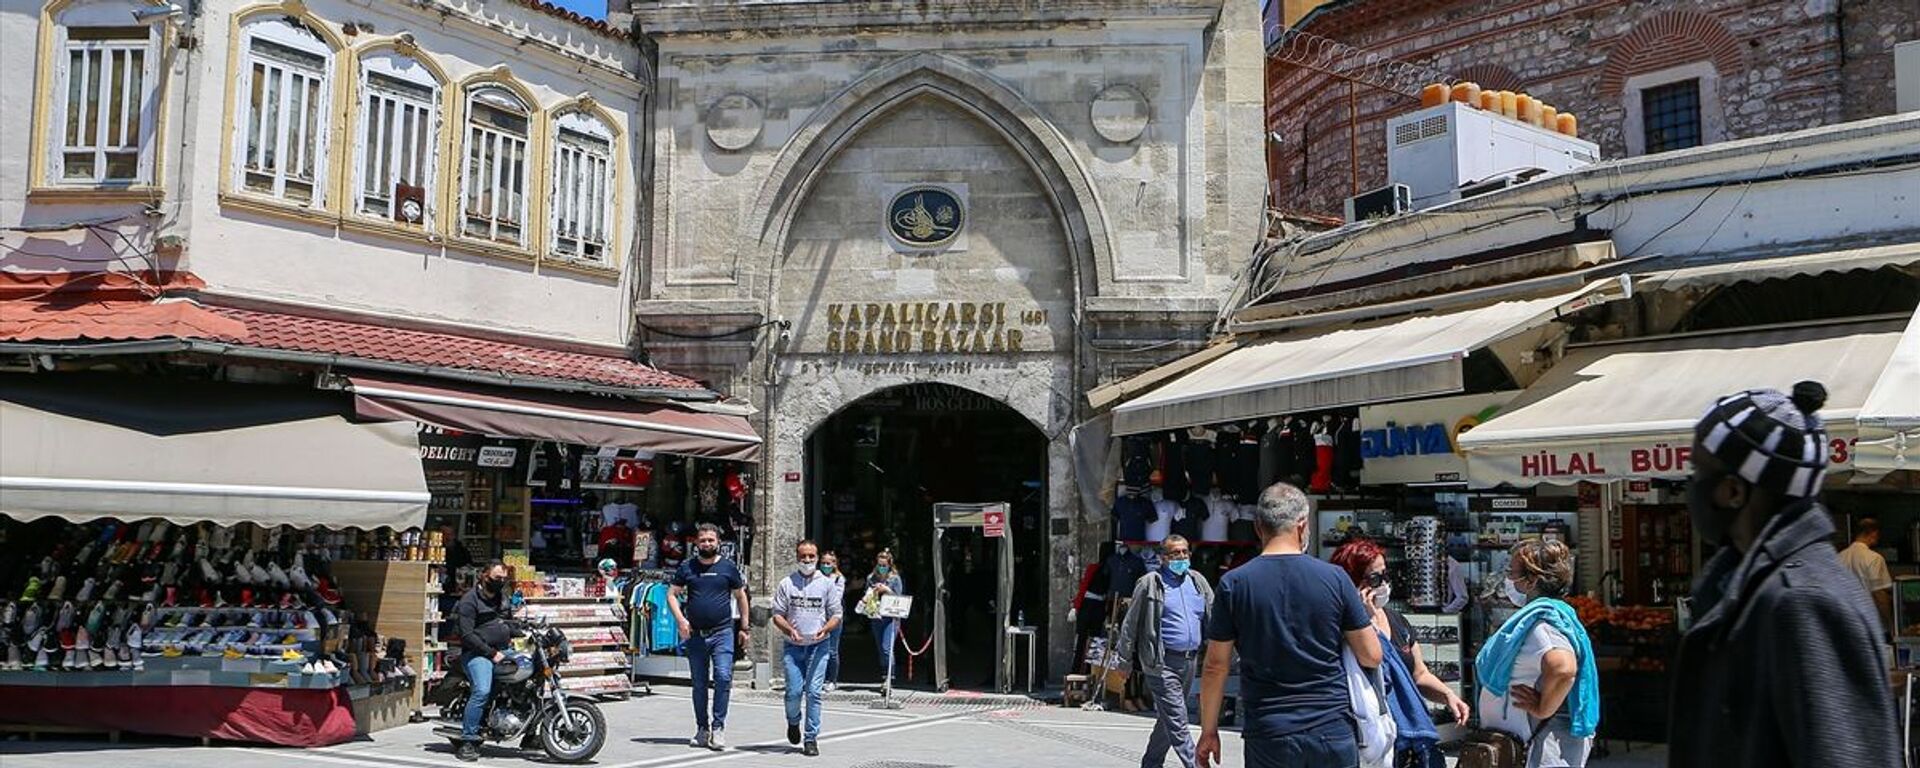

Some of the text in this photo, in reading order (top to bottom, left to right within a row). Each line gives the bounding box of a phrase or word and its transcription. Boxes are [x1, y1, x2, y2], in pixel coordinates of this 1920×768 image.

[827, 328, 1023, 354] GRAND BAZAAR
[419, 445, 476, 460] DELIGHT
[1361, 420, 1454, 458] DÜNYA
[1521, 444, 1693, 477] HİLAL BÜF
